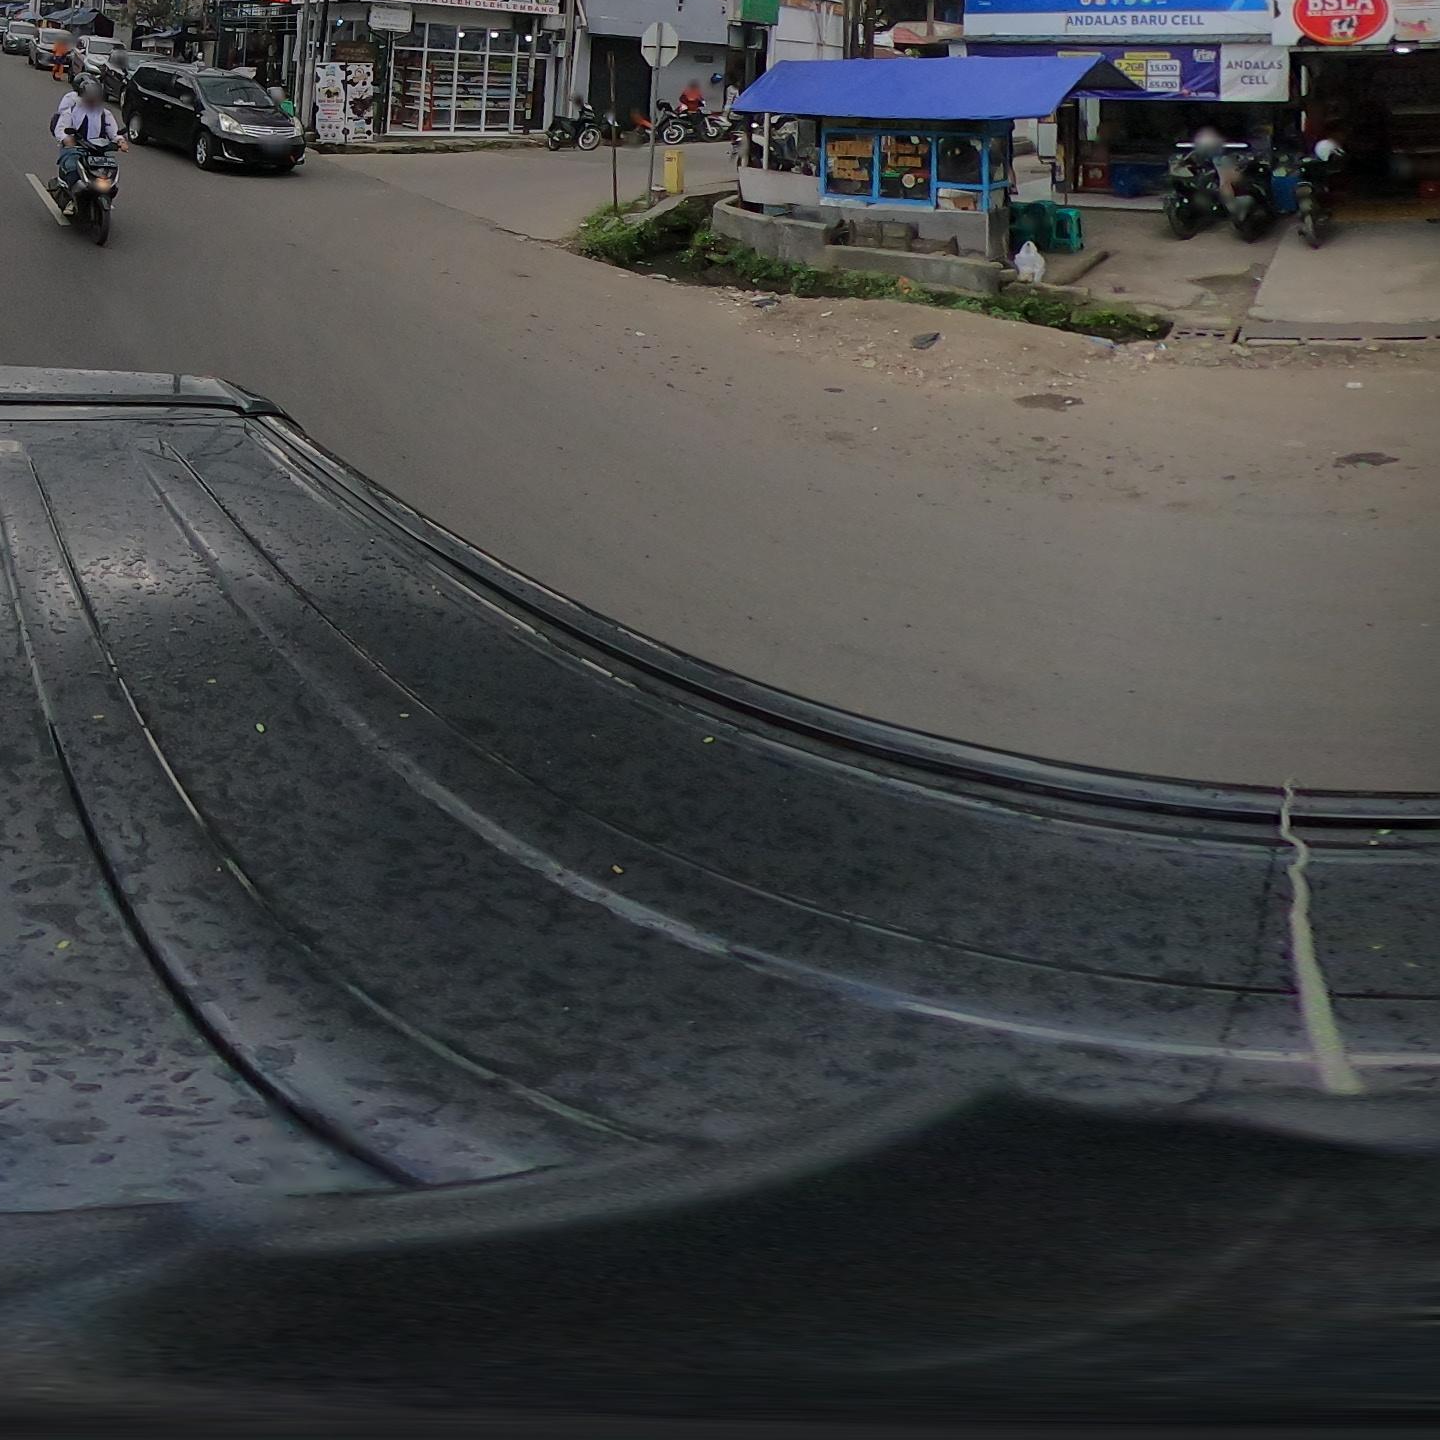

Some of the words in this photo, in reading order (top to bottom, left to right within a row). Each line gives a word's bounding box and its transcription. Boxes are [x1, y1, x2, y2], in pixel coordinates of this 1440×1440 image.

[1067, 14, 1128, 27] ANDALAS
[1131, 14, 1168, 26] BARU
[1171, 14, 1205, 25] CELL
[1226, 60, 1283, 70] ANDALAS
[1241, 75, 1268, 85] CELL
